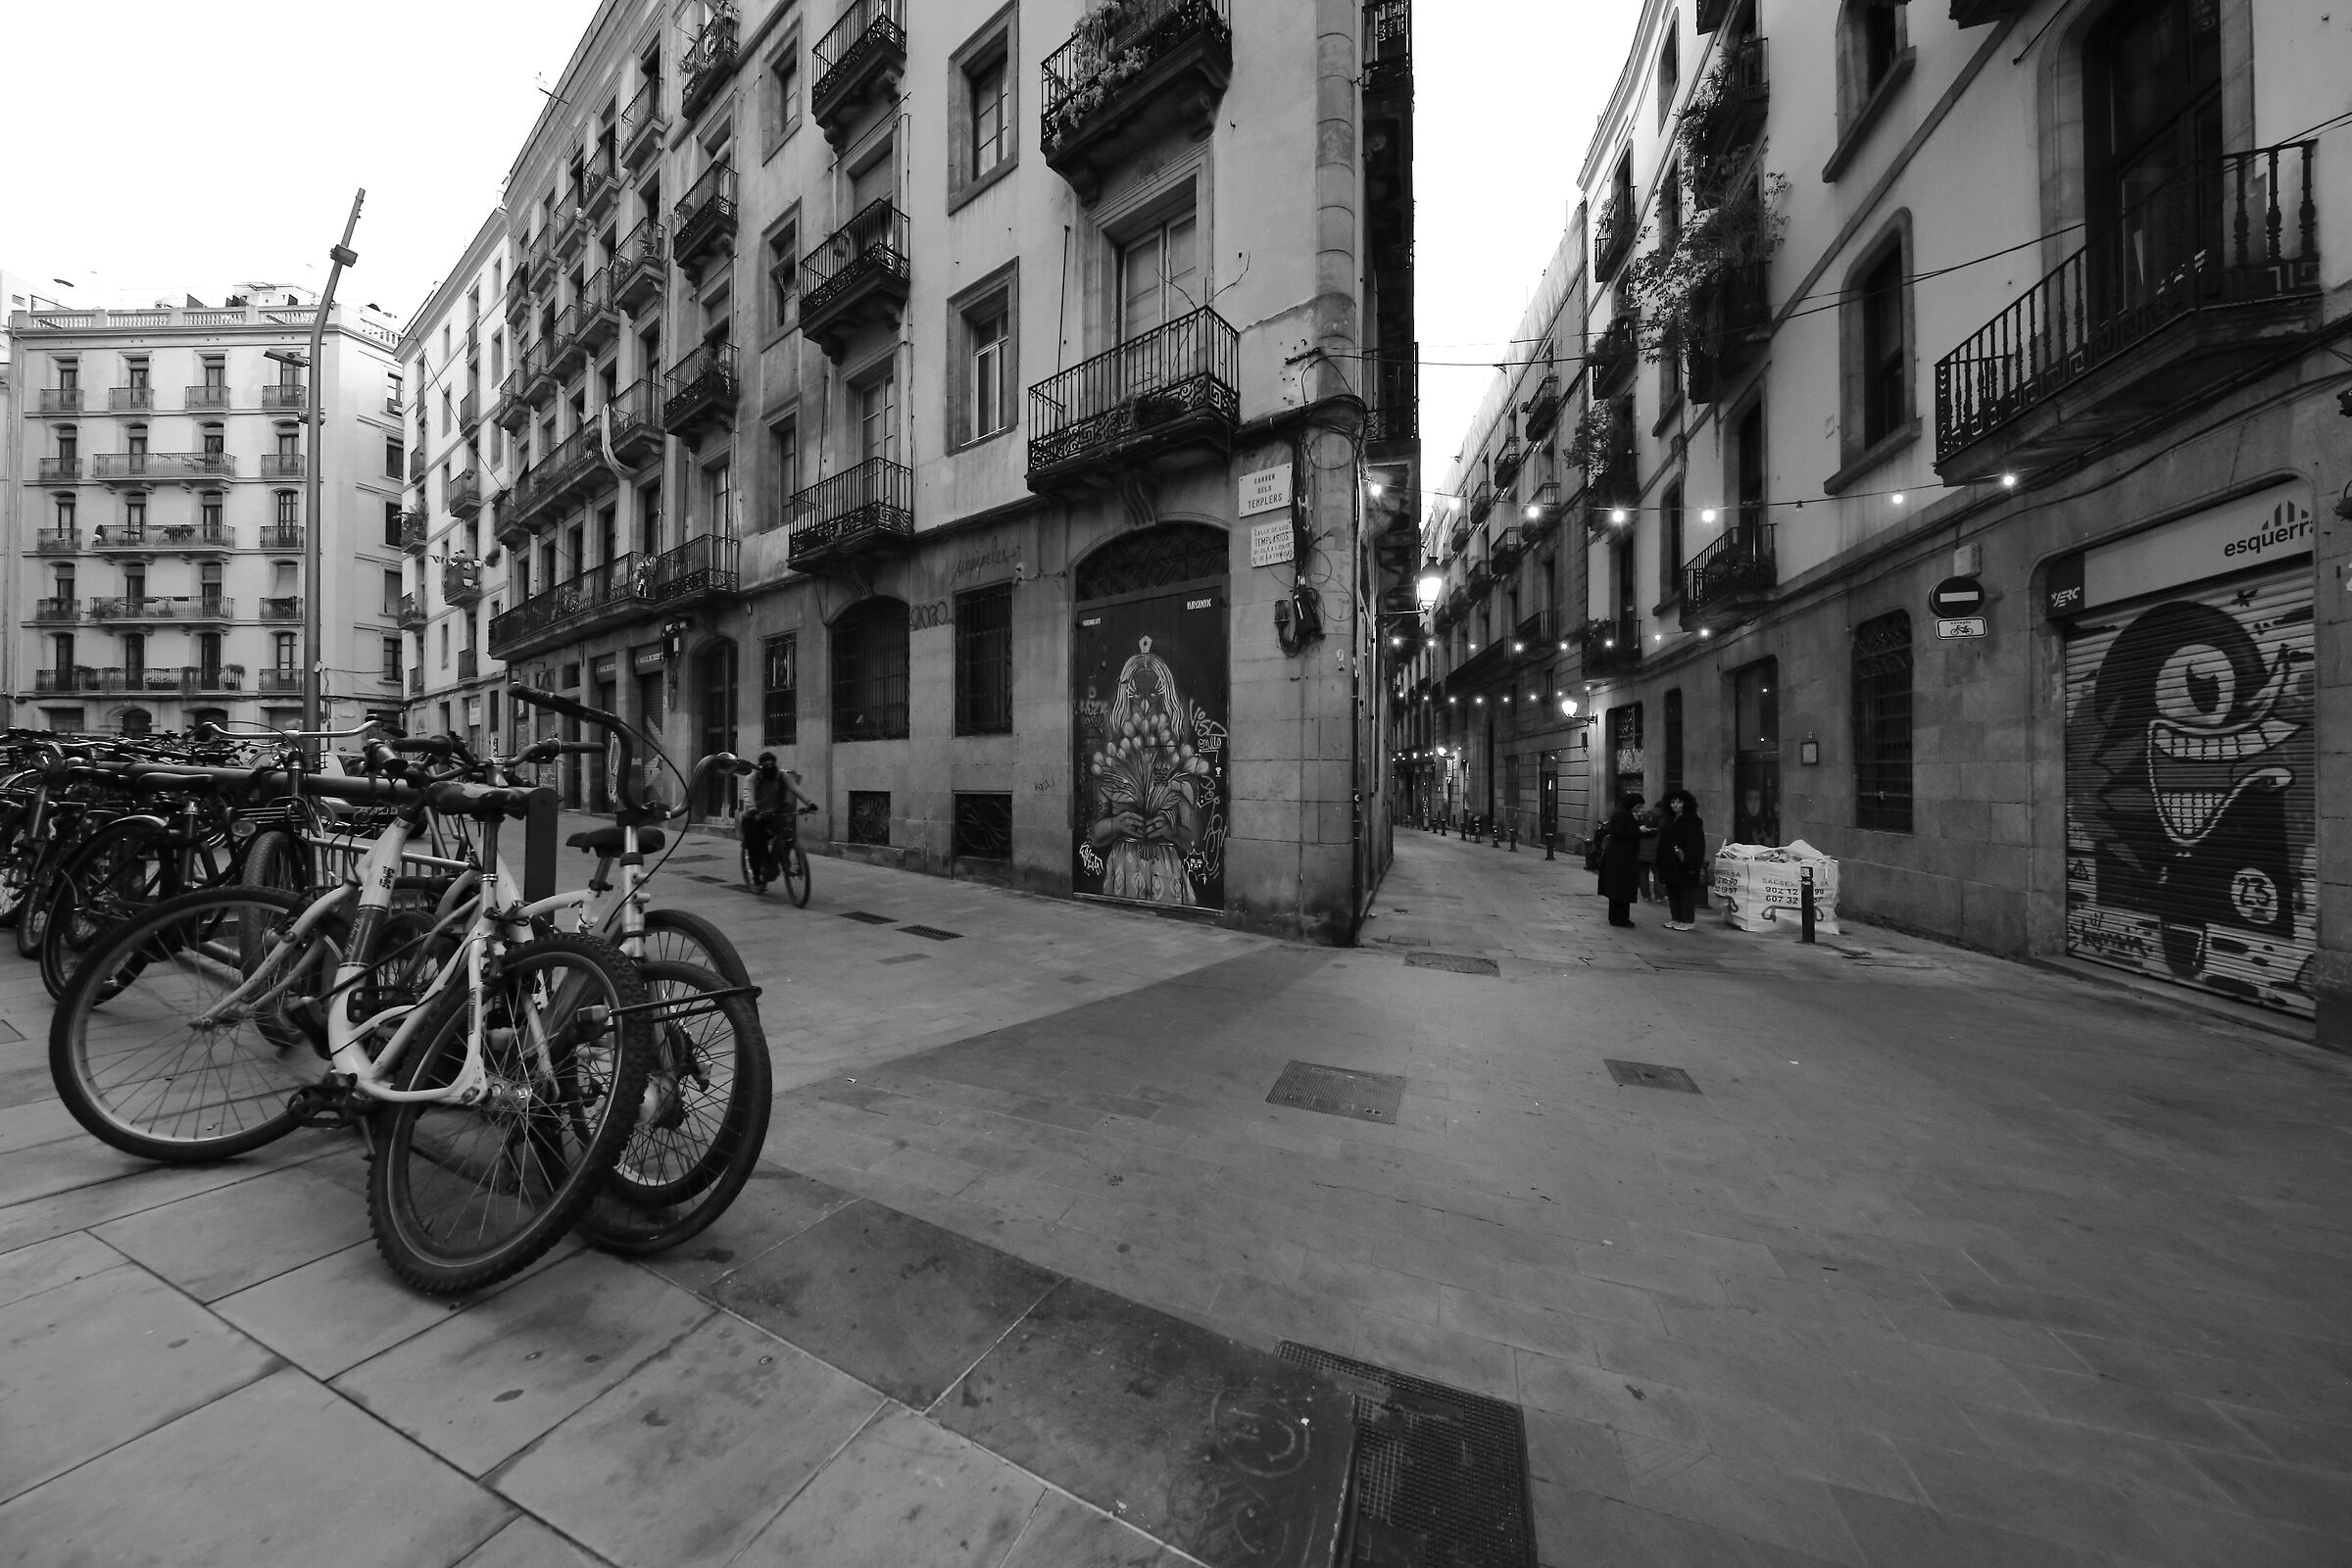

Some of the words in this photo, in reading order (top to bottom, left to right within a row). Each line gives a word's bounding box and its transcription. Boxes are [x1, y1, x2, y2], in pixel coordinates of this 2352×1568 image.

[1254, 473, 1275, 484] CARRER
[1257, 485, 1272, 494] DELS
[1248, 493, 1283, 509] TEMPLERS
